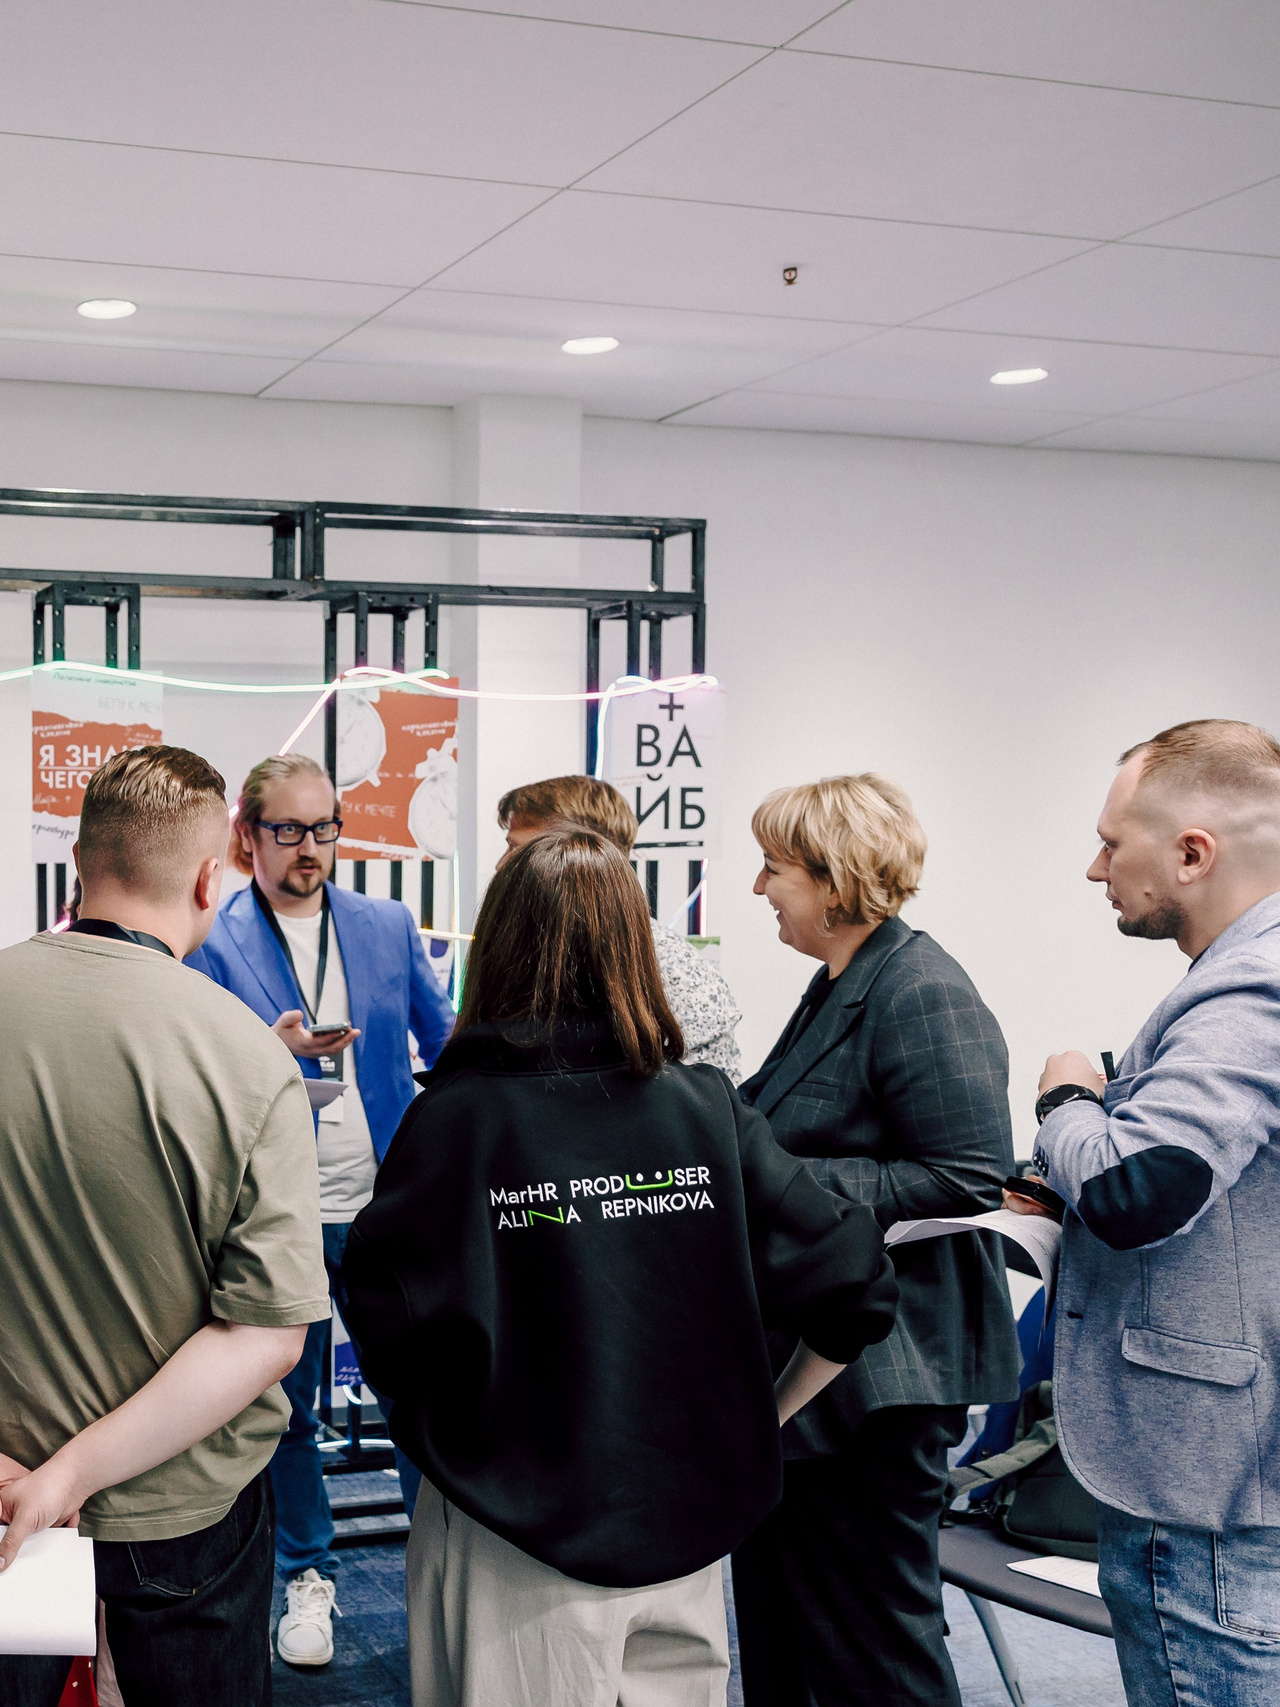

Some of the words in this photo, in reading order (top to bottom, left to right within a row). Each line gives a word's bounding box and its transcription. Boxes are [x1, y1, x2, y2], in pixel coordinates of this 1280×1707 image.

[38, 744, 56, 767] Я
[636, 723, 703, 768] ВА
[39, 770, 93, 790] ЧЕГО
[635, 773, 706, 831] ЙБ
[489, 1182, 559, 1208] MarHR
[497, 1204, 582, 1231] ALINA
[601, 1189, 715, 1220] REPNIKOVA
